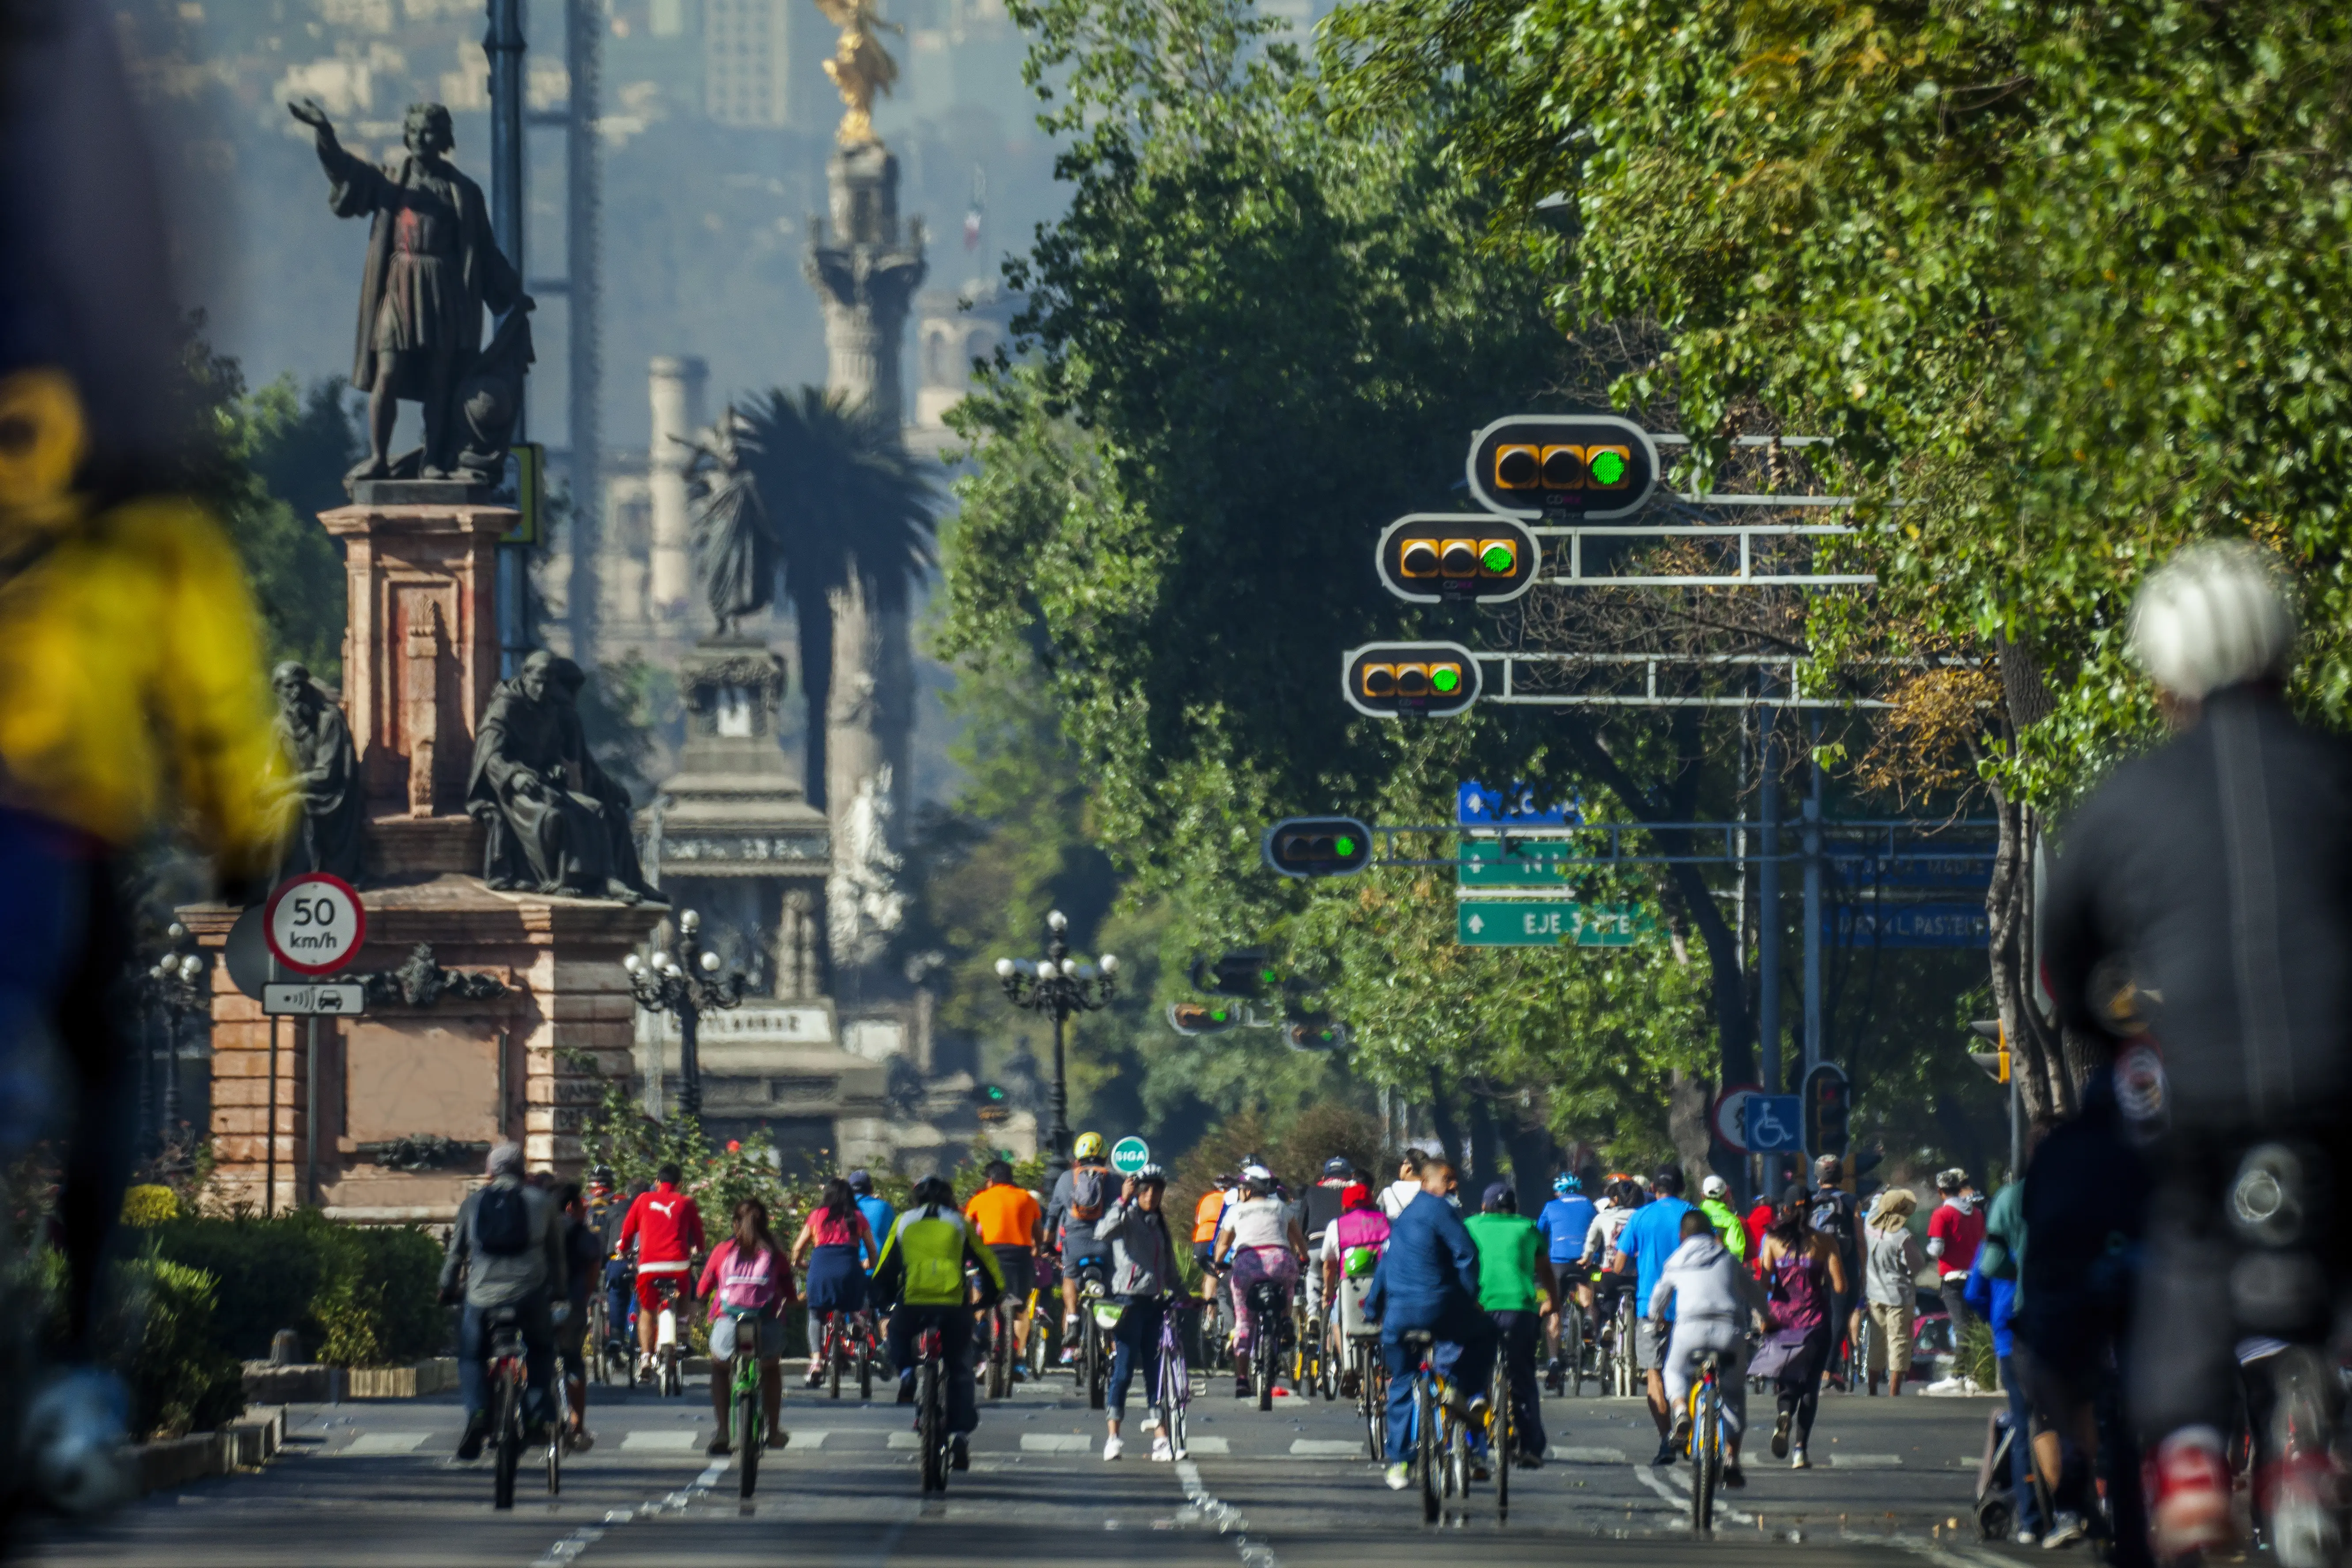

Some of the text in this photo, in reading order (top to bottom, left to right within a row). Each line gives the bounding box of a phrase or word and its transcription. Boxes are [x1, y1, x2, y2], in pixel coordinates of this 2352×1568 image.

[293, 898, 336, 926] 50
[1524, 913, 1561, 934] EJE
[290, 931, 337, 949] km/h
[1115, 1150, 1145, 1162] SIGA
